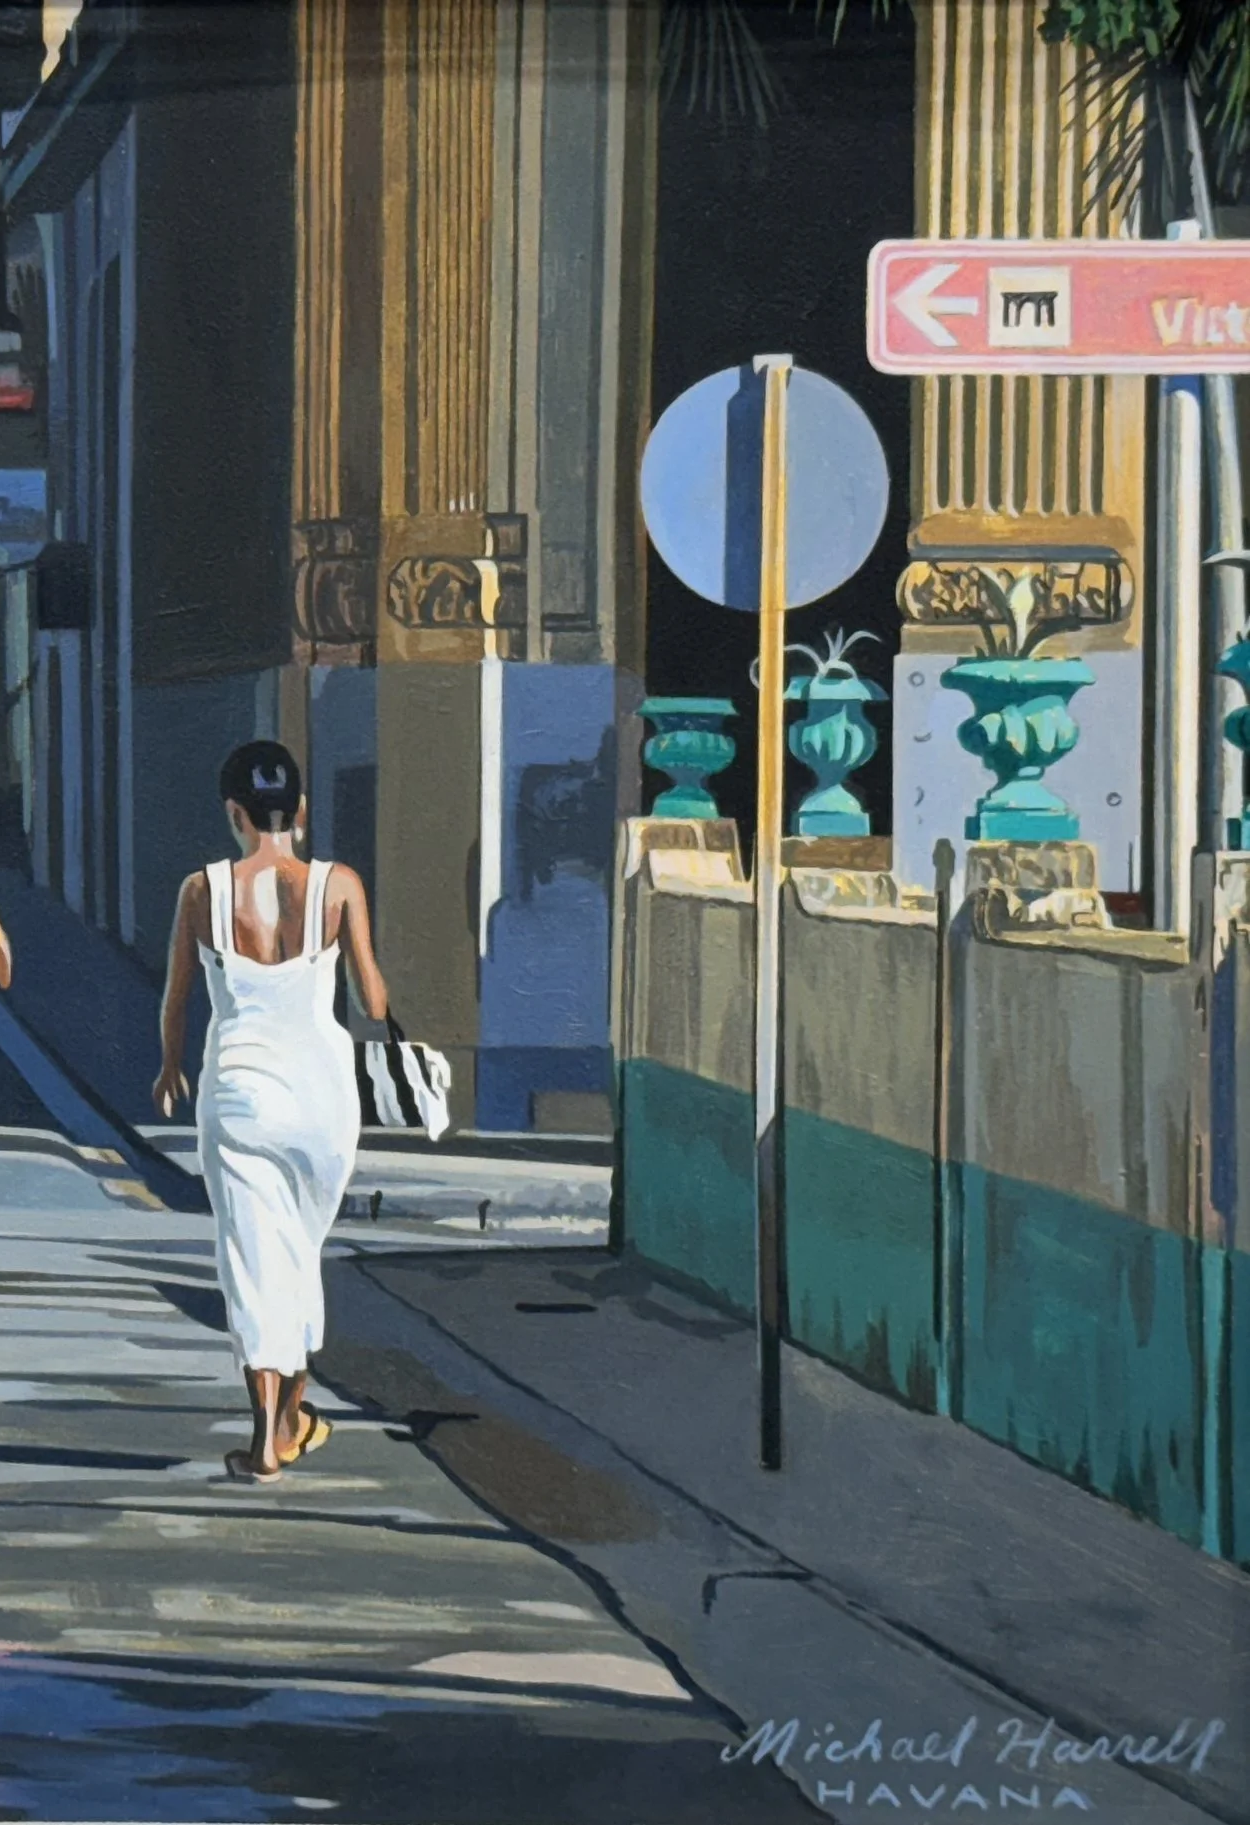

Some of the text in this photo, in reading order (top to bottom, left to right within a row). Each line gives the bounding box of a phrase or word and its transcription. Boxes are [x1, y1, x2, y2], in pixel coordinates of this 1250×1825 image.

[720, 1715, 1226, 1773] Michael Harrell
[817, 1780, 1095, 1811] HAVANA
